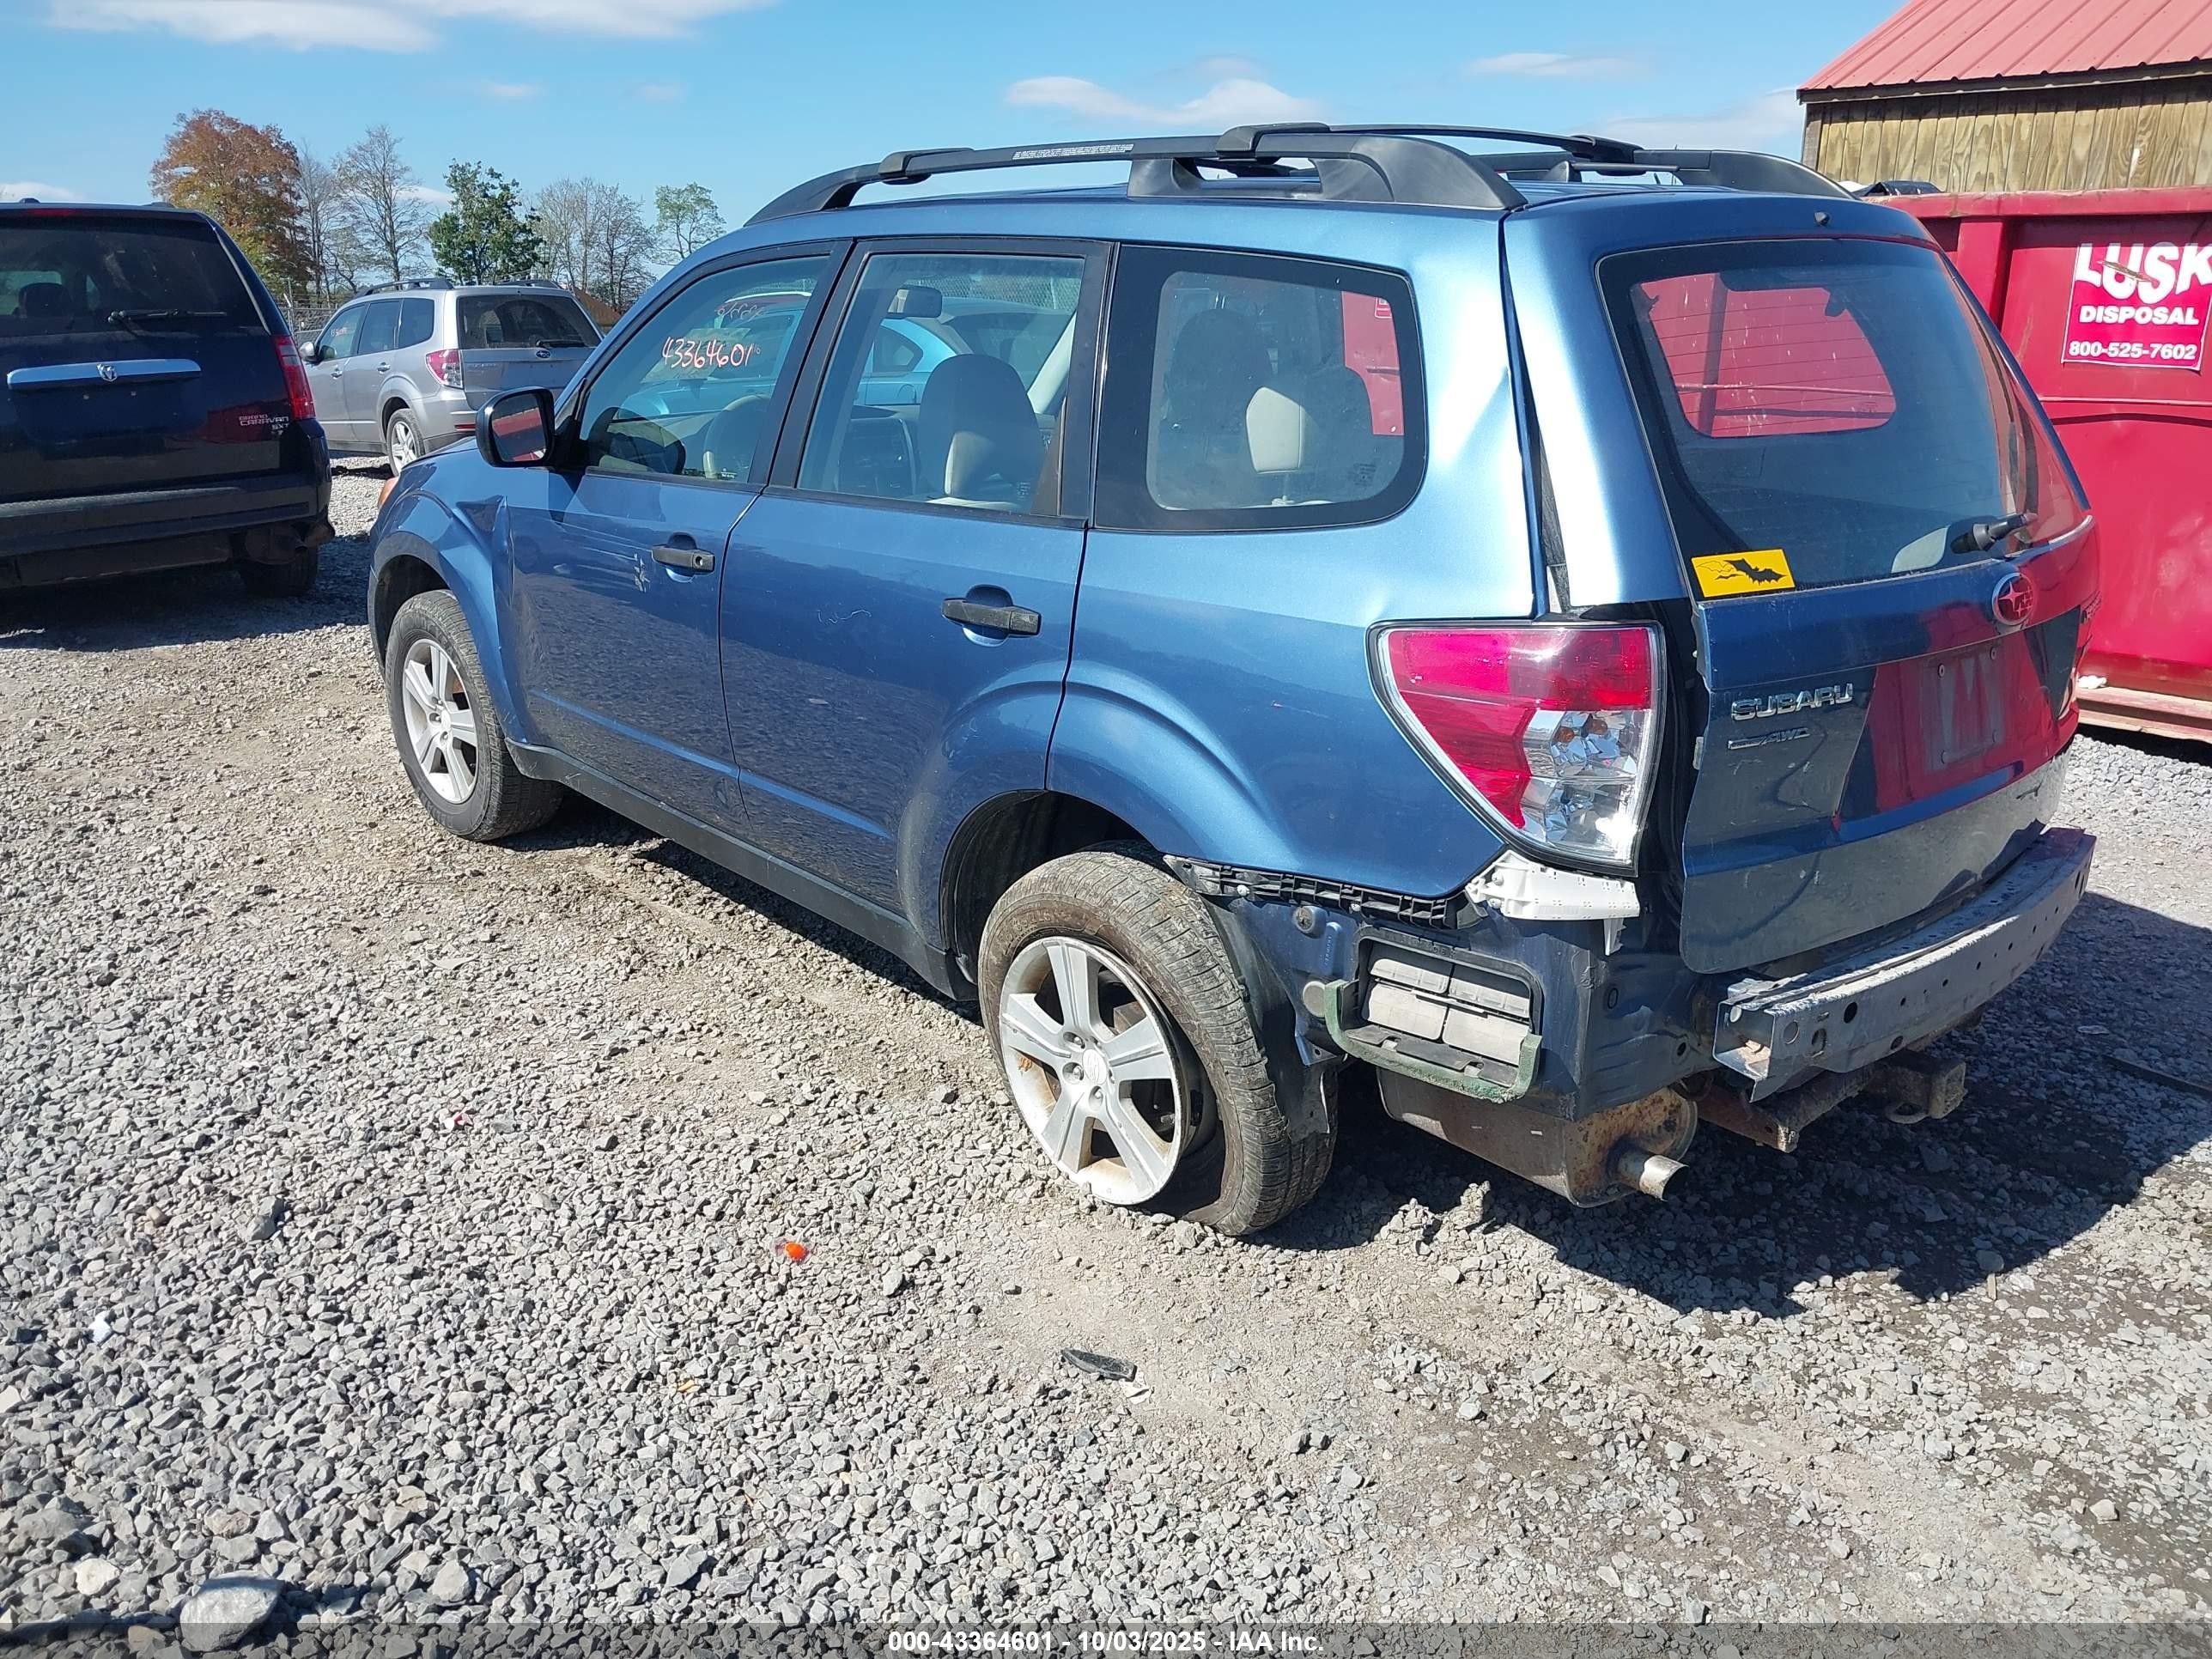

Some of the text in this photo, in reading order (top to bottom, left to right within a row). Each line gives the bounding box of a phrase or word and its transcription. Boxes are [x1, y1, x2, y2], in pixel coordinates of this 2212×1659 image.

[2075, 241, 2212, 304] LUSK
[2080, 306, 2199, 325] DISPOSAL
[662, 337, 752, 368] 43364601
[2068, 341, 2197, 360] 800-525-7602
[240, 416, 289, 426] CARAVAN
[1731, 683, 1852, 720] SUBARU
